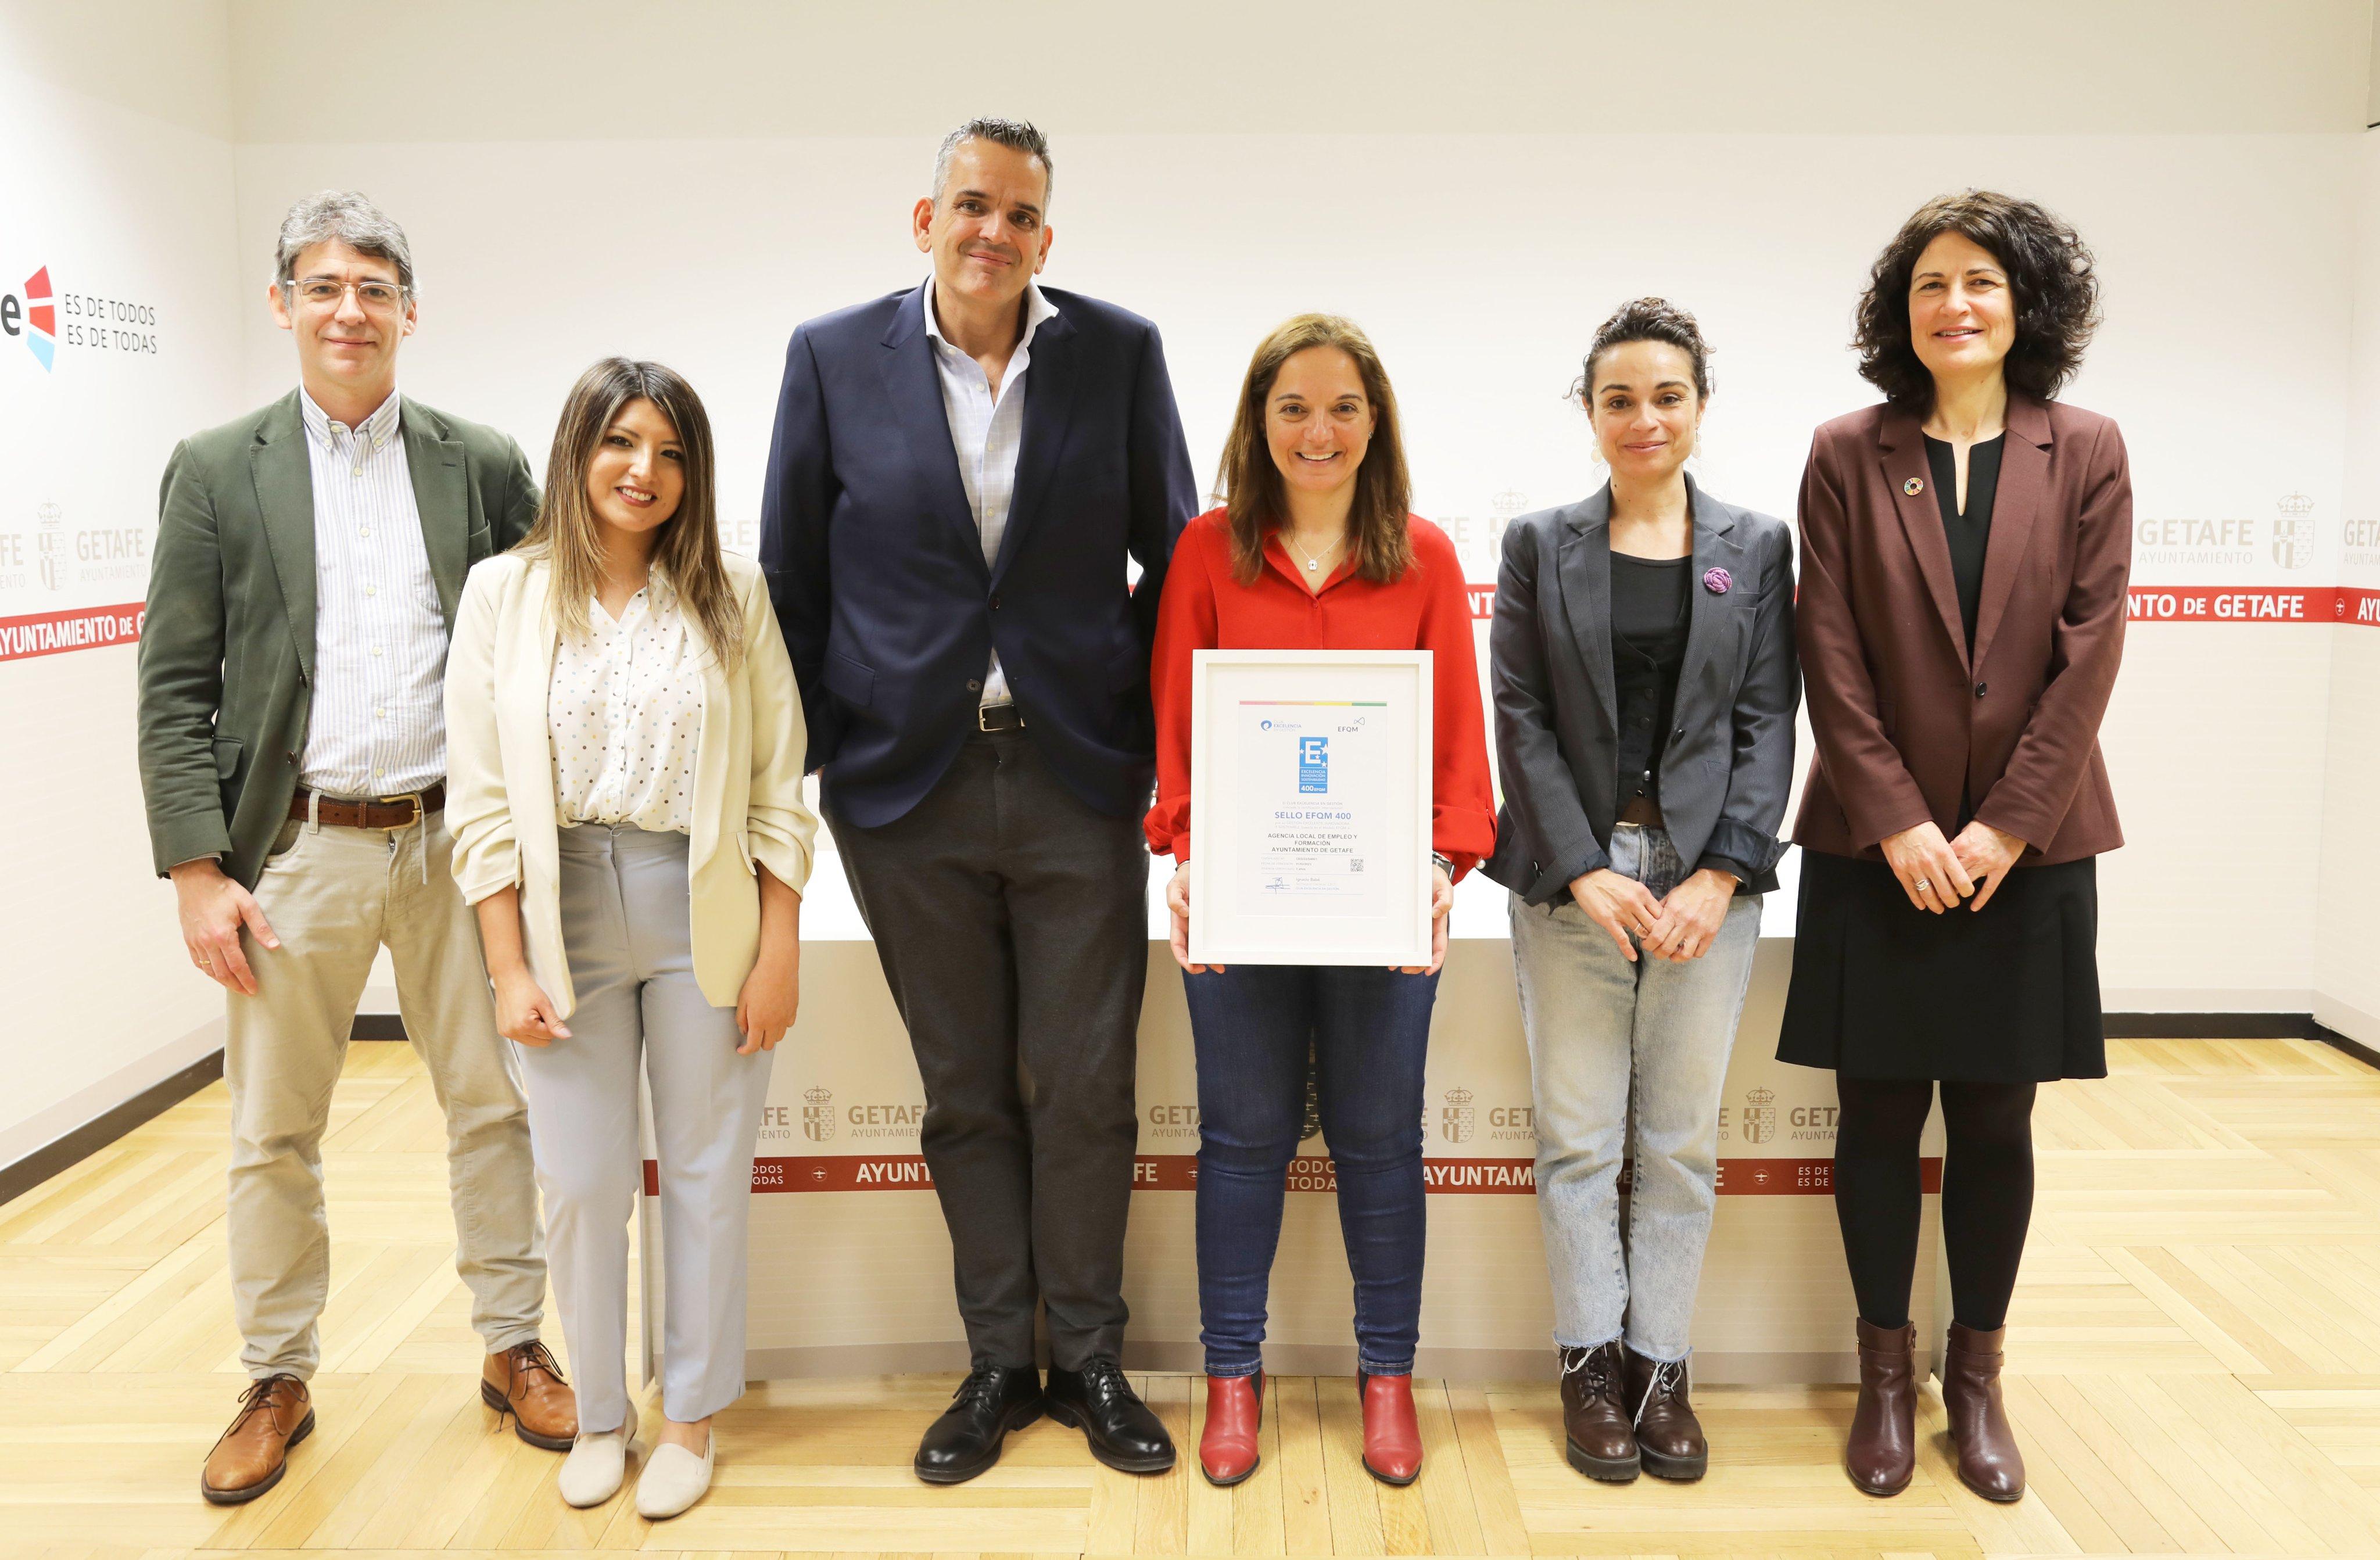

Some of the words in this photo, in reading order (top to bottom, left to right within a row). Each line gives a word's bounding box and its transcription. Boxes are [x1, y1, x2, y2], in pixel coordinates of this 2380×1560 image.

[66, 294, 81, 314] ES
[87, 297, 105, 318] DE
[109, 301, 156, 325] TODOS
[68, 325, 83, 345] ES
[90, 328, 107, 348] DE
[113, 331, 157, 354] TODAS
[2137, 519, 2254, 546] GETAFE
[76, 528, 145, 561] GETAFE
[2138, 551, 2253, 565] AYUNTAMIENTO
[80, 564, 146, 582] AYUNTAMIENTO
[2183, 597, 2206, 615] DE
[2214, 594, 2304, 618] GETAFE
[120, 617, 134, 636] DE
[1275, 811, 1303, 819] SELLO
[1306, 812, 1332, 820] EFQM
[848, 1105, 929, 1125] GETAF
[1149, 1105, 1201, 1125] GET
[1489, 1107, 1532, 1127] GET
[1790, 1107, 1840, 1127] GET
[851, 1128, 922, 1138] AYUNTAMIEN
[1152, 1128, 1199, 1138] AYUNTA
[1491, 1131, 1535, 1140] AYUNTA
[1791, 1131, 1835, 1140] AYUNTA
[752, 1165, 783, 1174] ODOS
[1289, 1160, 1336, 1174] TODO
[1798, 1167, 1811, 1175] ES
[1815, 1167, 1829, 1175] DE
[752, 1176, 783, 1185] ODAS
[1288, 1177, 1338, 1190] TODA
[1423, 1165, 1533, 1186] AYUNTAM
[1798, 1178, 1810, 1186] ES
[1815, 1178, 1829, 1186] DE
